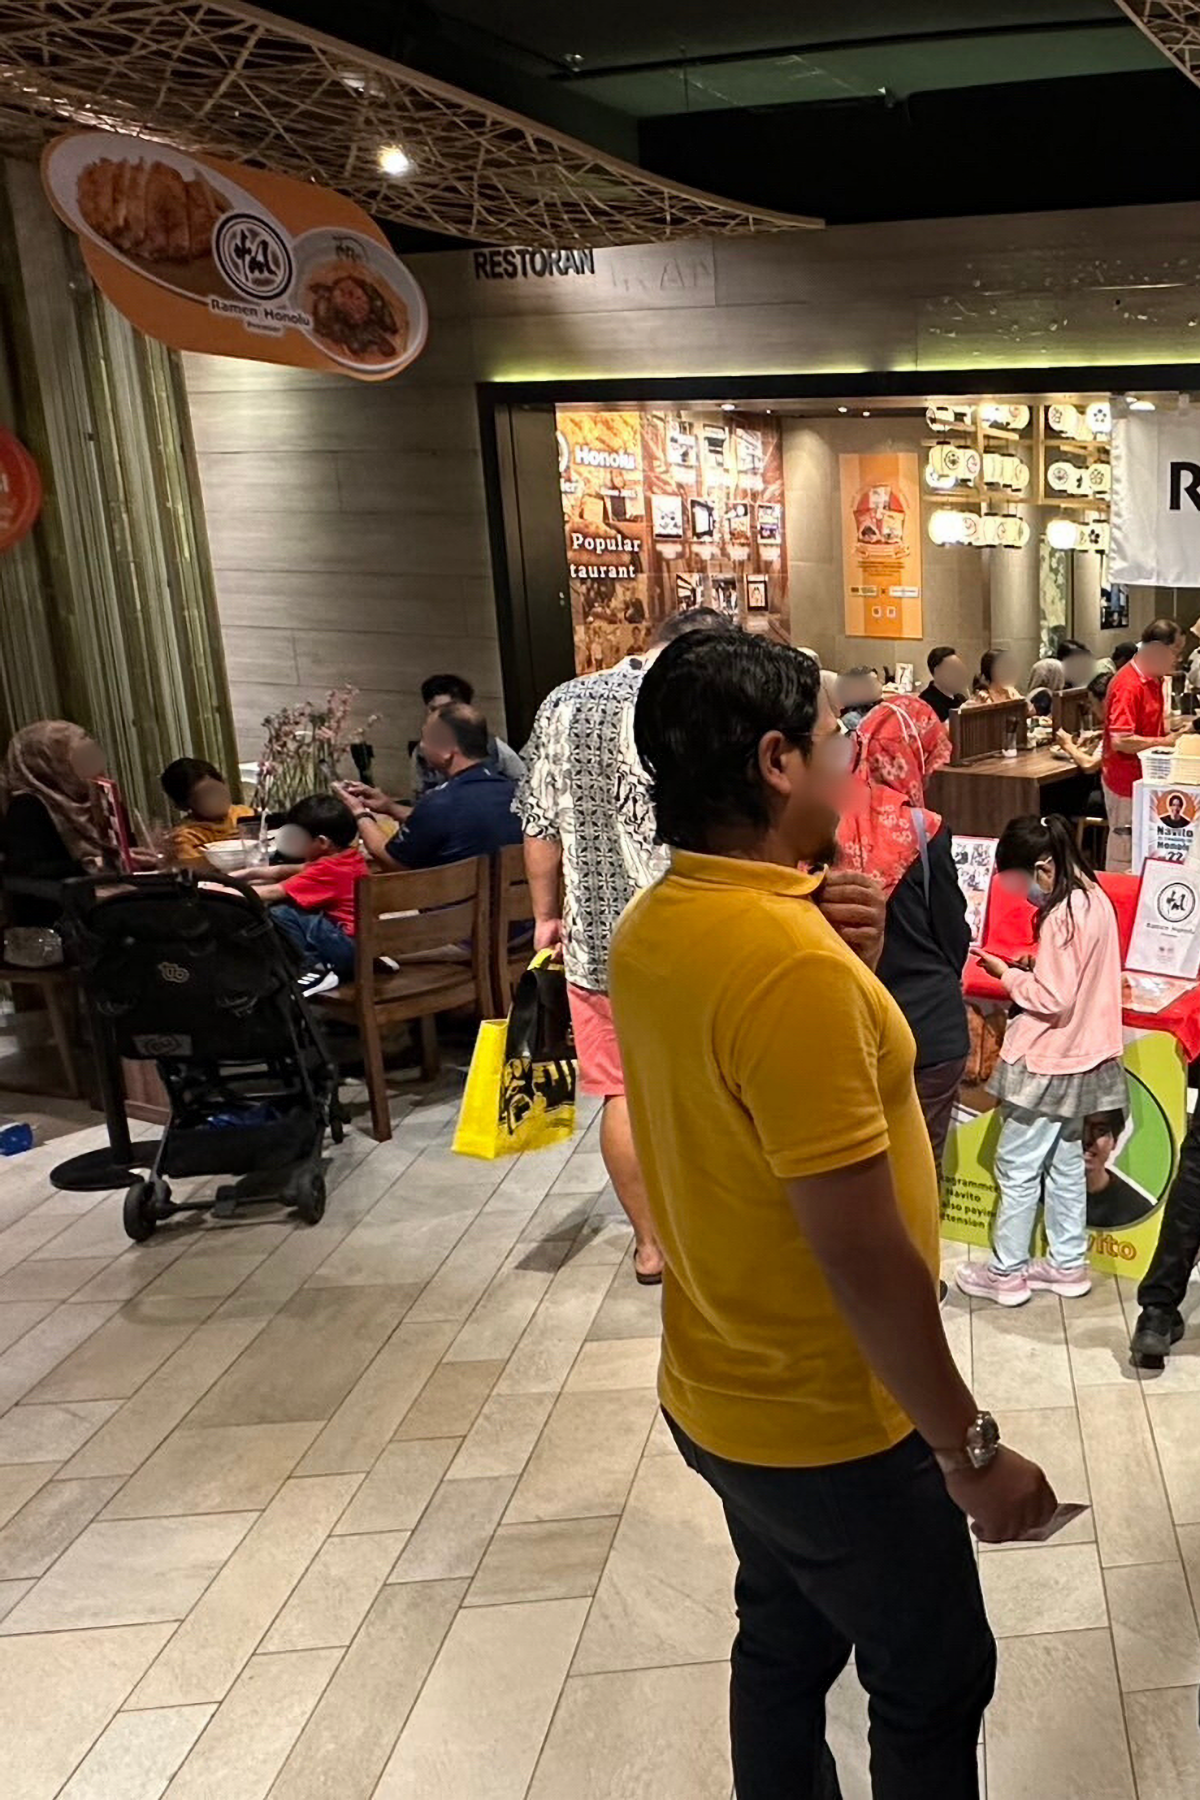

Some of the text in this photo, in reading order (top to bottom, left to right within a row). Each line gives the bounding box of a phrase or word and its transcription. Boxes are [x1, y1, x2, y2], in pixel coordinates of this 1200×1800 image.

[473, 248, 595, 280] RESTORAN
[211, 299, 311, 326] Ramen Honolu
[575, 444, 635, 469] Honolu
[571, 533, 640, 554] Popular
[570, 563, 636, 578] taurant
